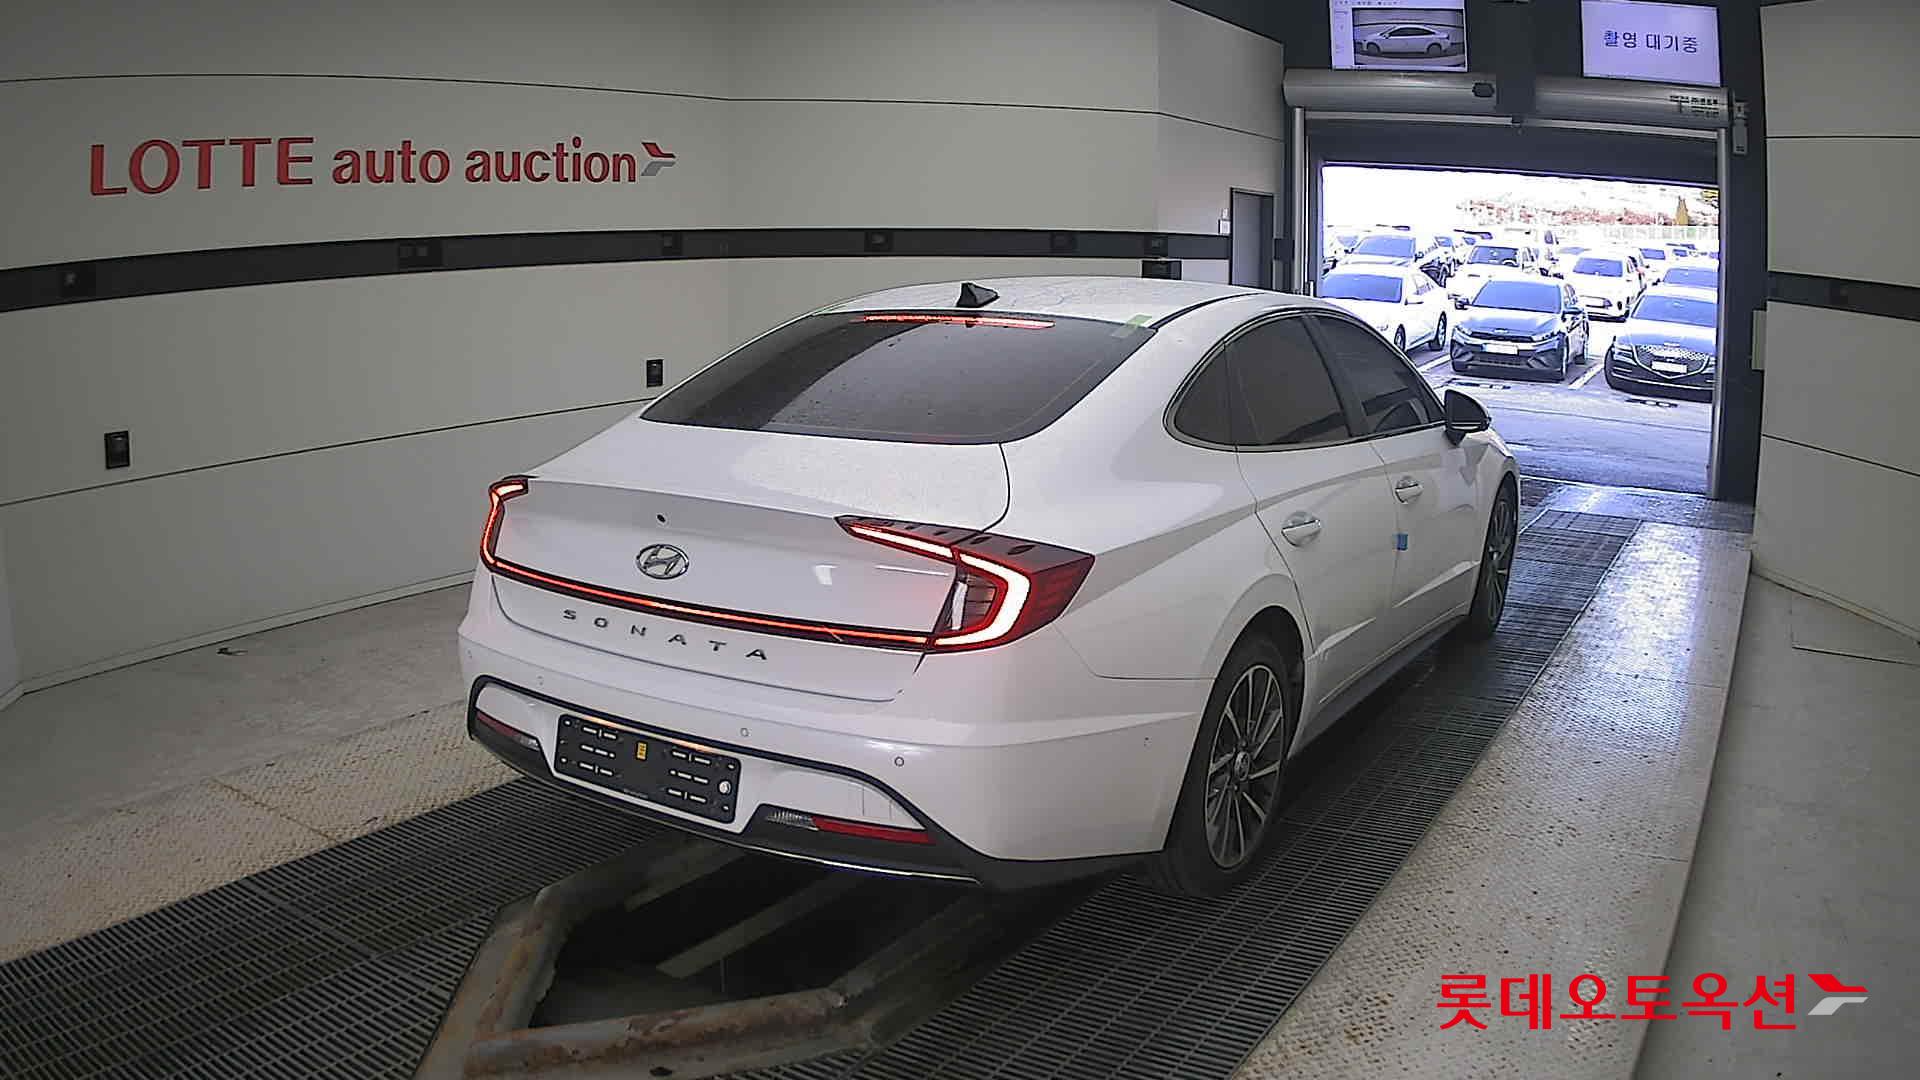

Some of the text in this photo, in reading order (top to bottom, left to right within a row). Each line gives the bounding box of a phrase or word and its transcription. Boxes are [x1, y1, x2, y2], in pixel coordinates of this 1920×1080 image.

[1603, 30, 1698, 54] 촬영 대기중
[90, 136, 637, 196] LOTTE auto auction
[562, 608, 768, 661] SONATA
